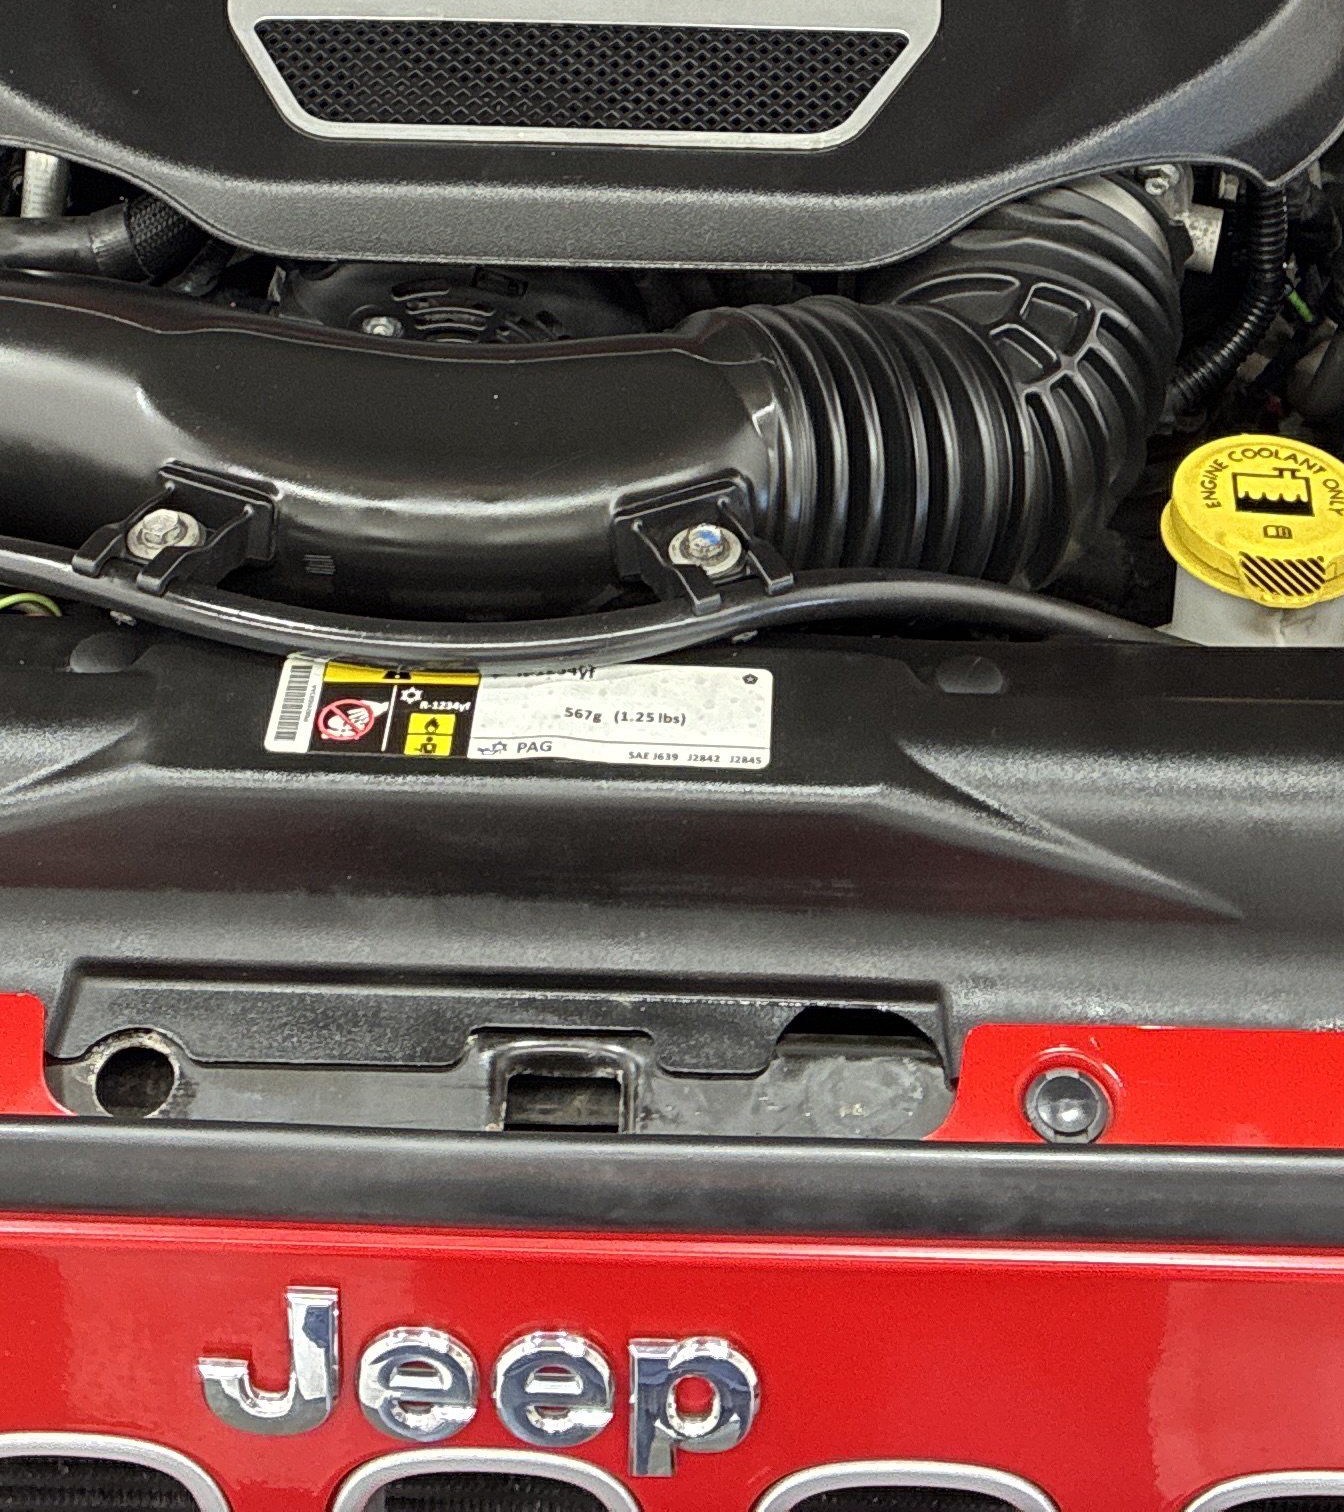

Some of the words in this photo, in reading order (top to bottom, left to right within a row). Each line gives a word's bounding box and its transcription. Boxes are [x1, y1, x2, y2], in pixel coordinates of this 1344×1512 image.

[1200, 458, 1229, 510] ENGINE
[1227, 447, 1327, 475] COOLANT
[418, 699, 472, 713] R-1234yf
[563, 706, 603, 724] 567g
[613, 709, 655, 725] (1.25
[658, 711, 687, 727] lbs)
[516, 740, 554, 754] PAG
[628, 750, 650, 761] SAE
[653, 751, 679, 762] J639
[196, 1284, 760, 1478] Jeep
